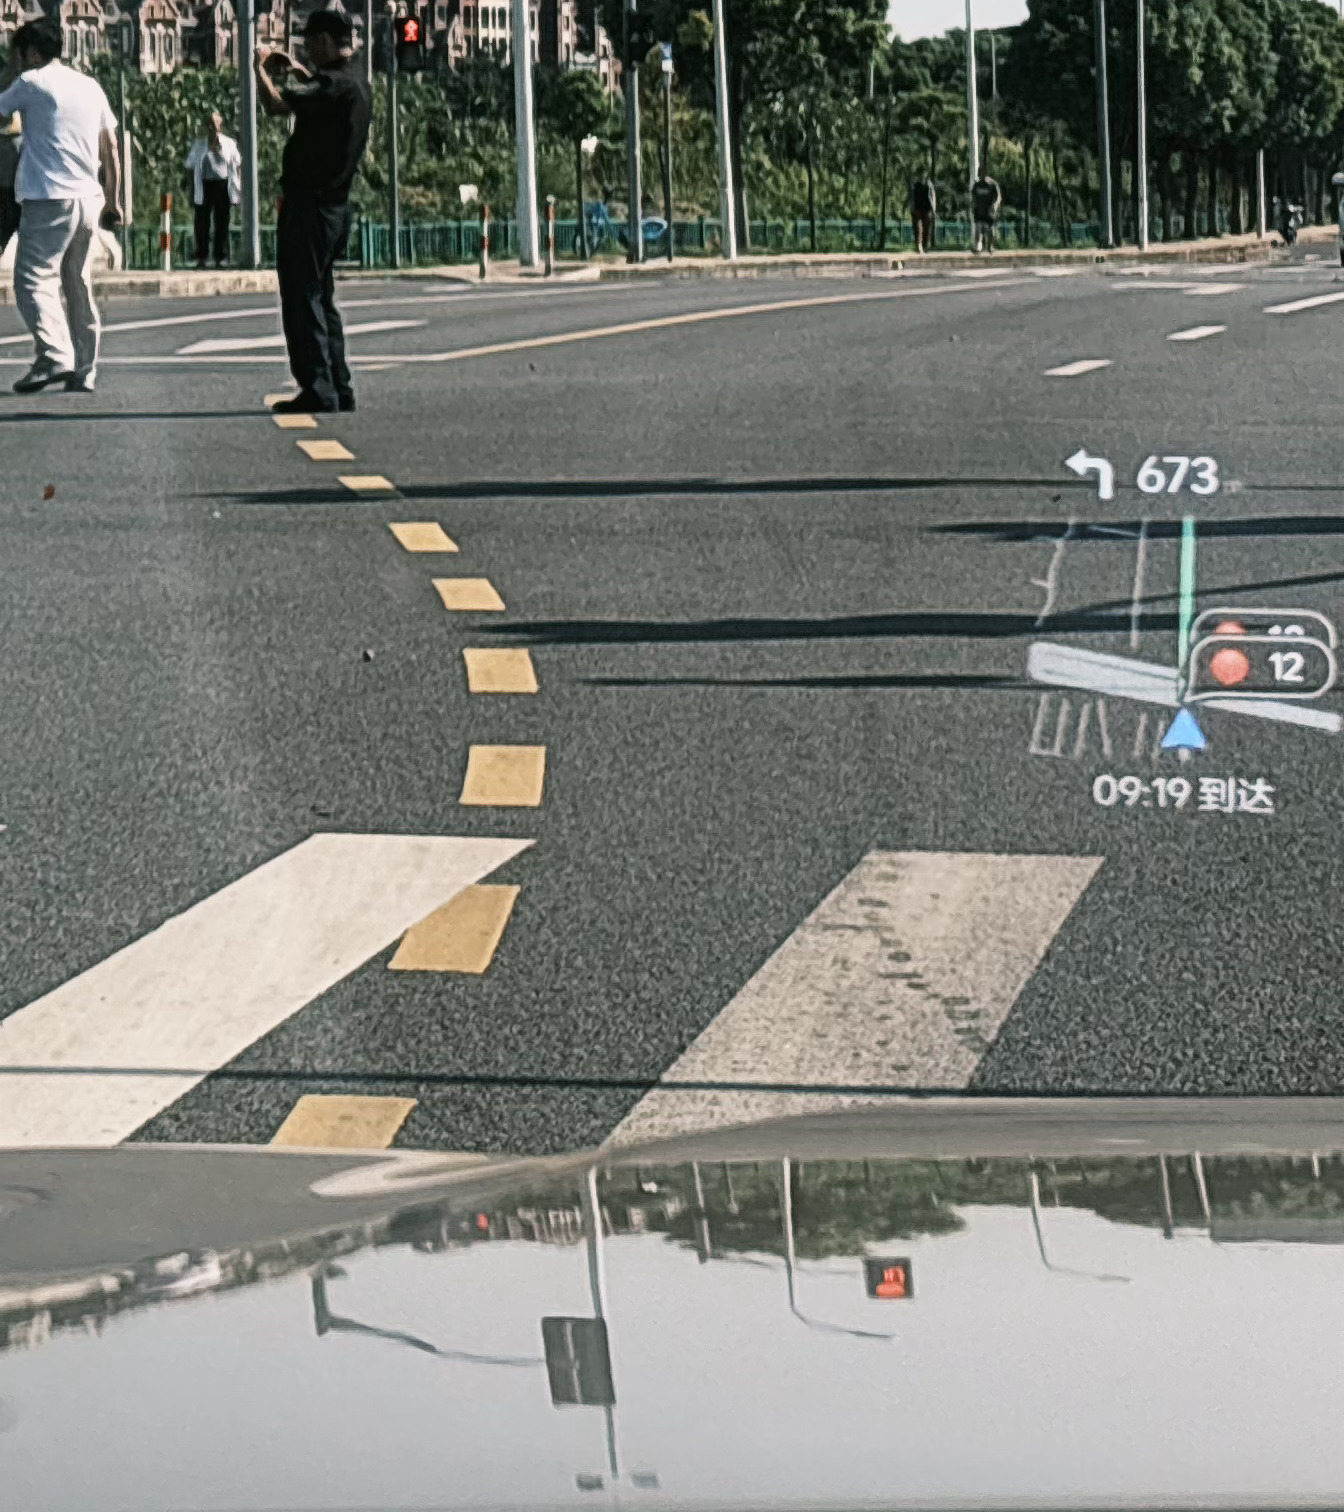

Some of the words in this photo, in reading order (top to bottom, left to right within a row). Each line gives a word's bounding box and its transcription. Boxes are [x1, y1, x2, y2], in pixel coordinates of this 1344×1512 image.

[1136, 455, 1219, 495] 673
[1268, 651, 1305, 682] 12
[1092, 773, 1193, 808] 09:19
[1198, 776, 1276, 814] 到达
